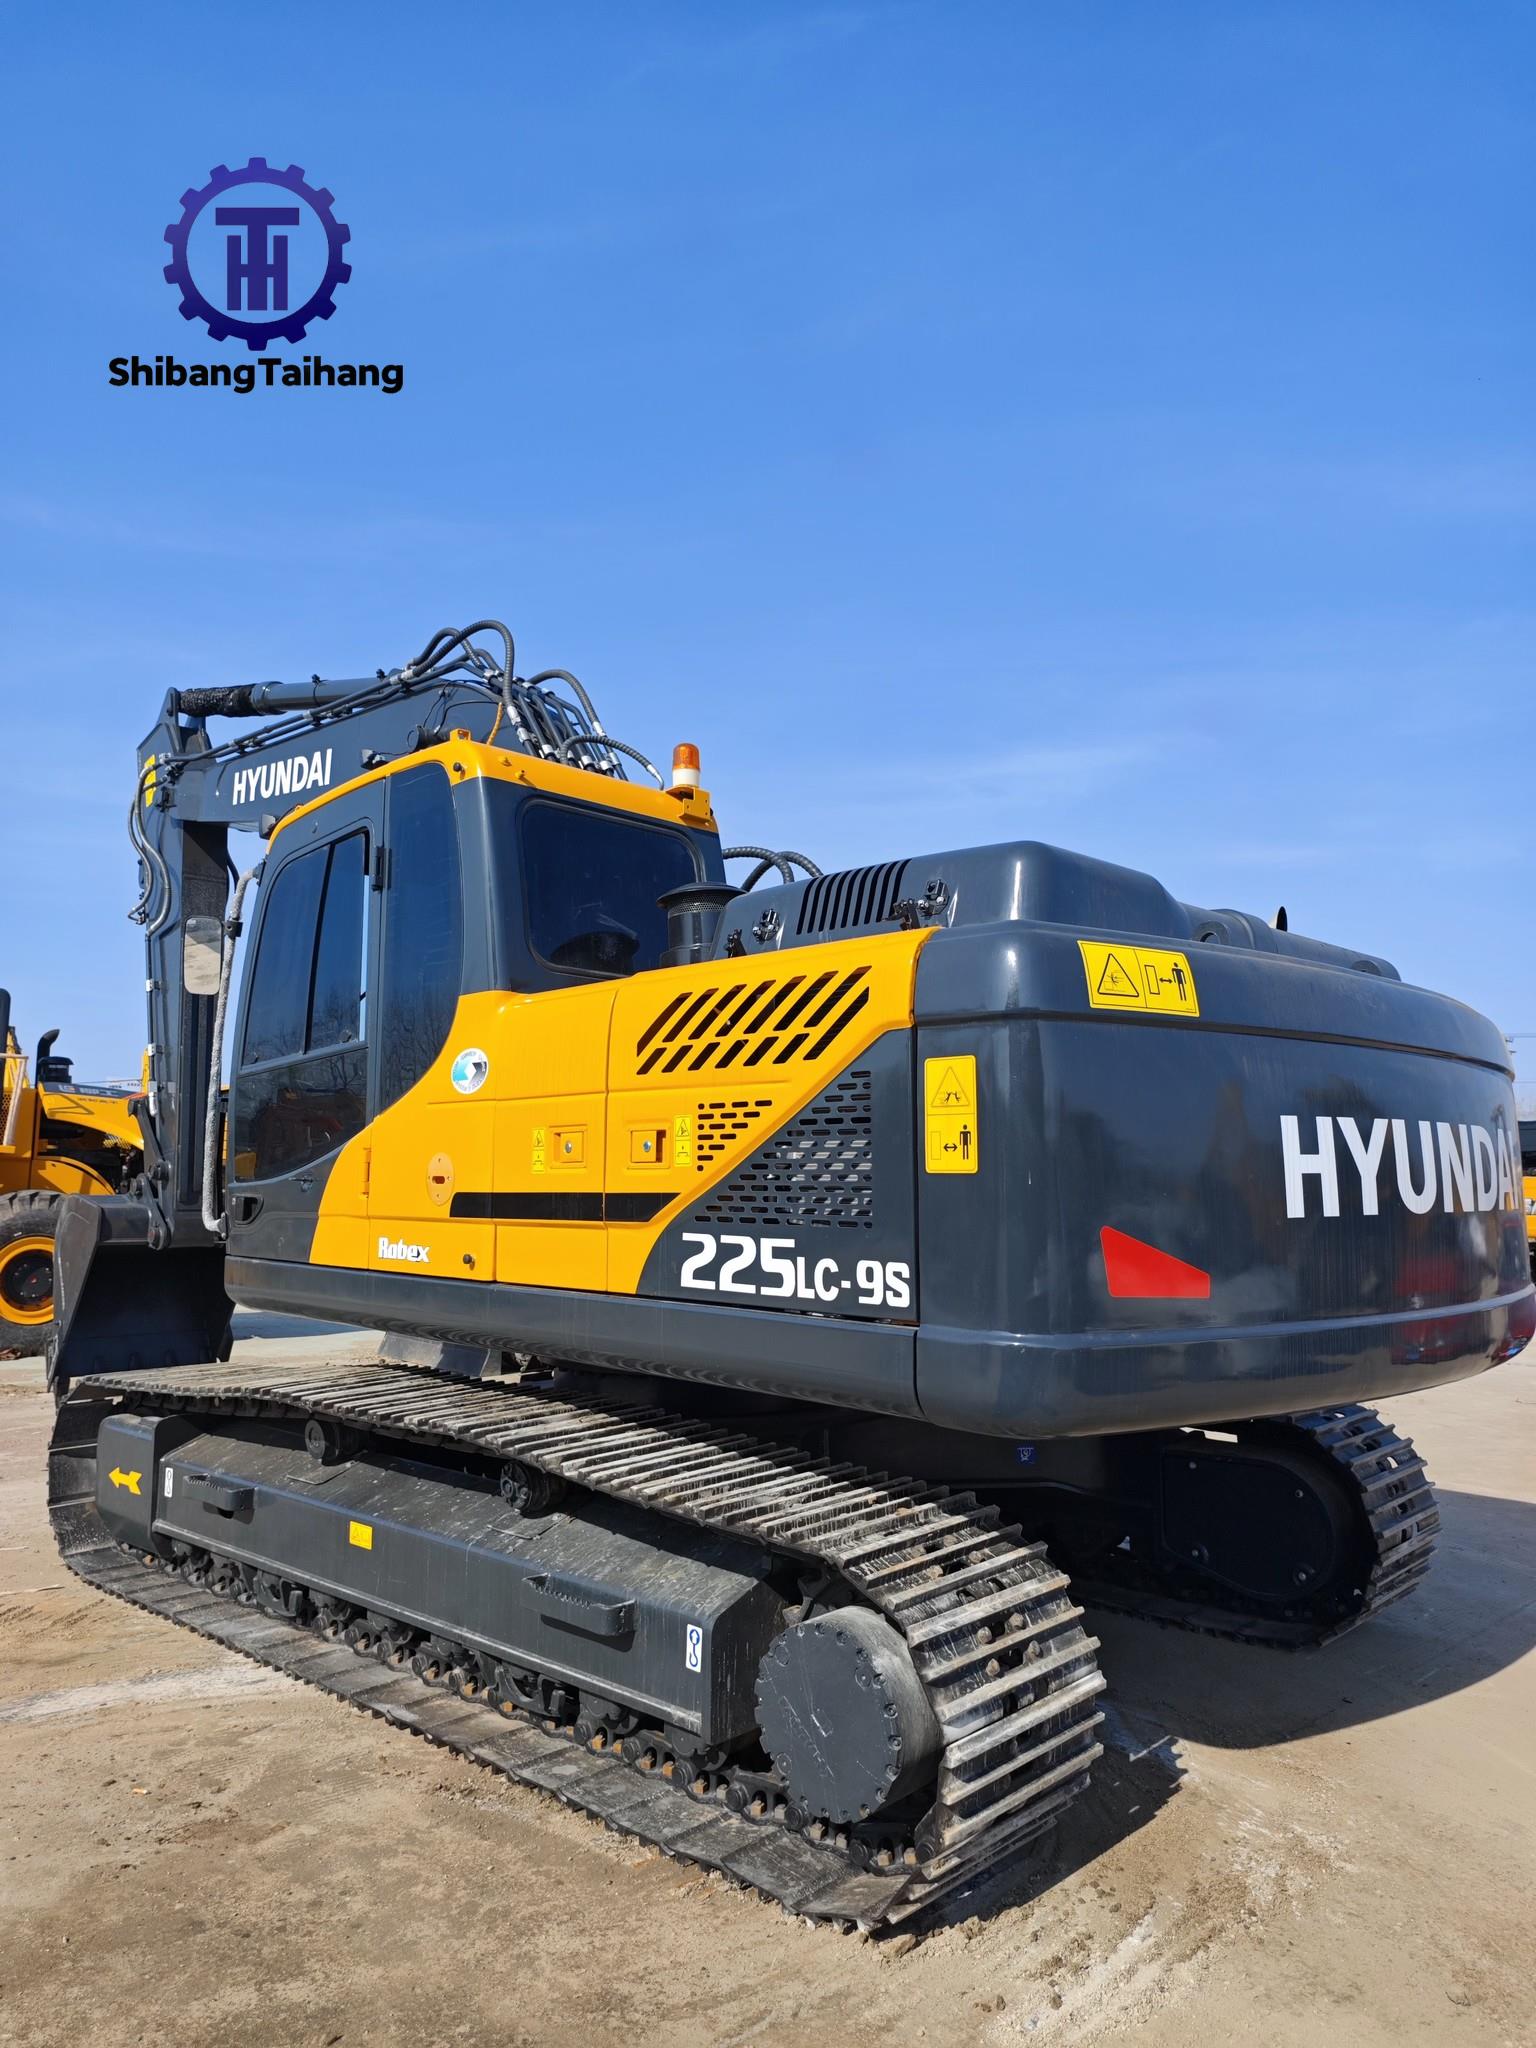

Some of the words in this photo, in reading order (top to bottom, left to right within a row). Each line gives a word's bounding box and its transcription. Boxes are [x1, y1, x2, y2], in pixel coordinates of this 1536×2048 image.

[232, 748, 333, 806] HYUNDAI
[1280, 1115, 1520, 1218] HYUNDAI
[378, 1236, 430, 1263] Robex
